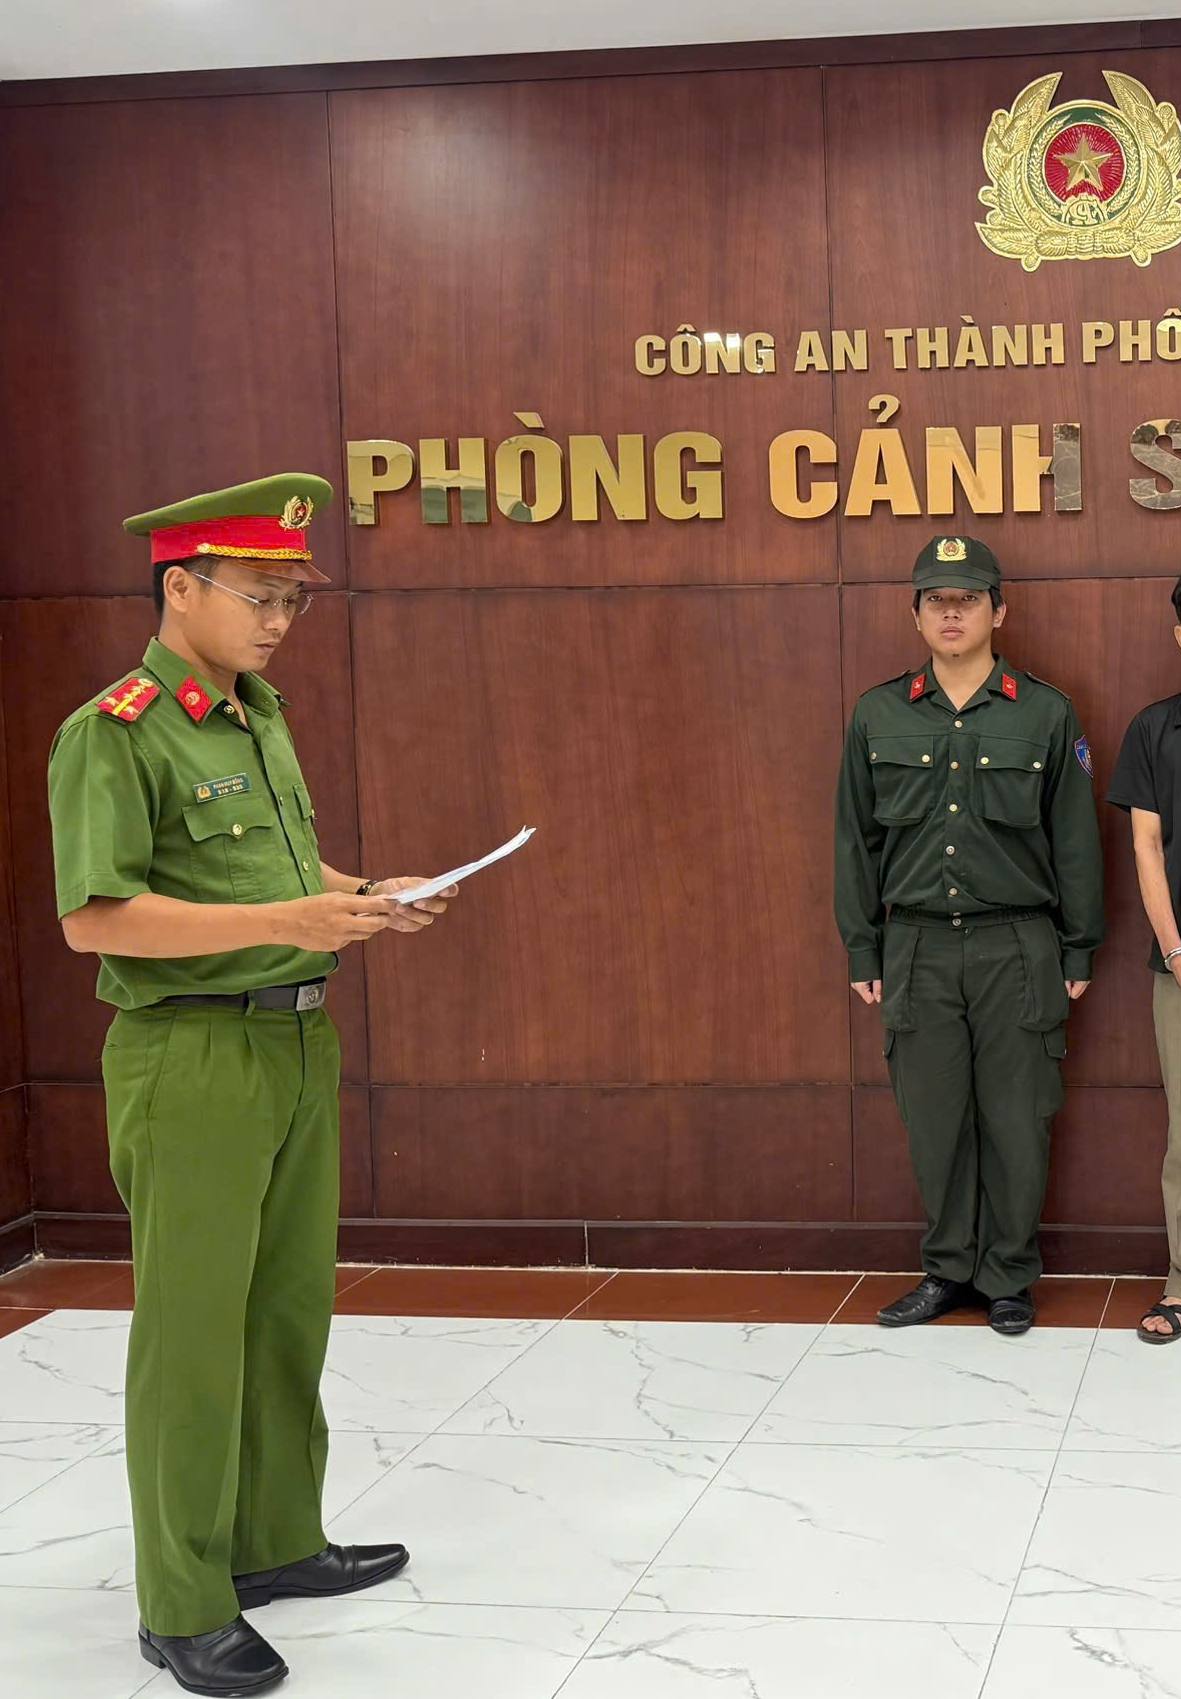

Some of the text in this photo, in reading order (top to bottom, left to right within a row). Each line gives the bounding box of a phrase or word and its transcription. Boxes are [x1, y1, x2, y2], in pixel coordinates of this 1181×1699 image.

[634, 323, 777, 376] CÔNG
[794, 328, 870, 372] AN
[884, 314, 1066, 370] THÀNH
[346, 412, 725, 526] PHÒNG
[768, 394, 1083, 519] CẢNH
